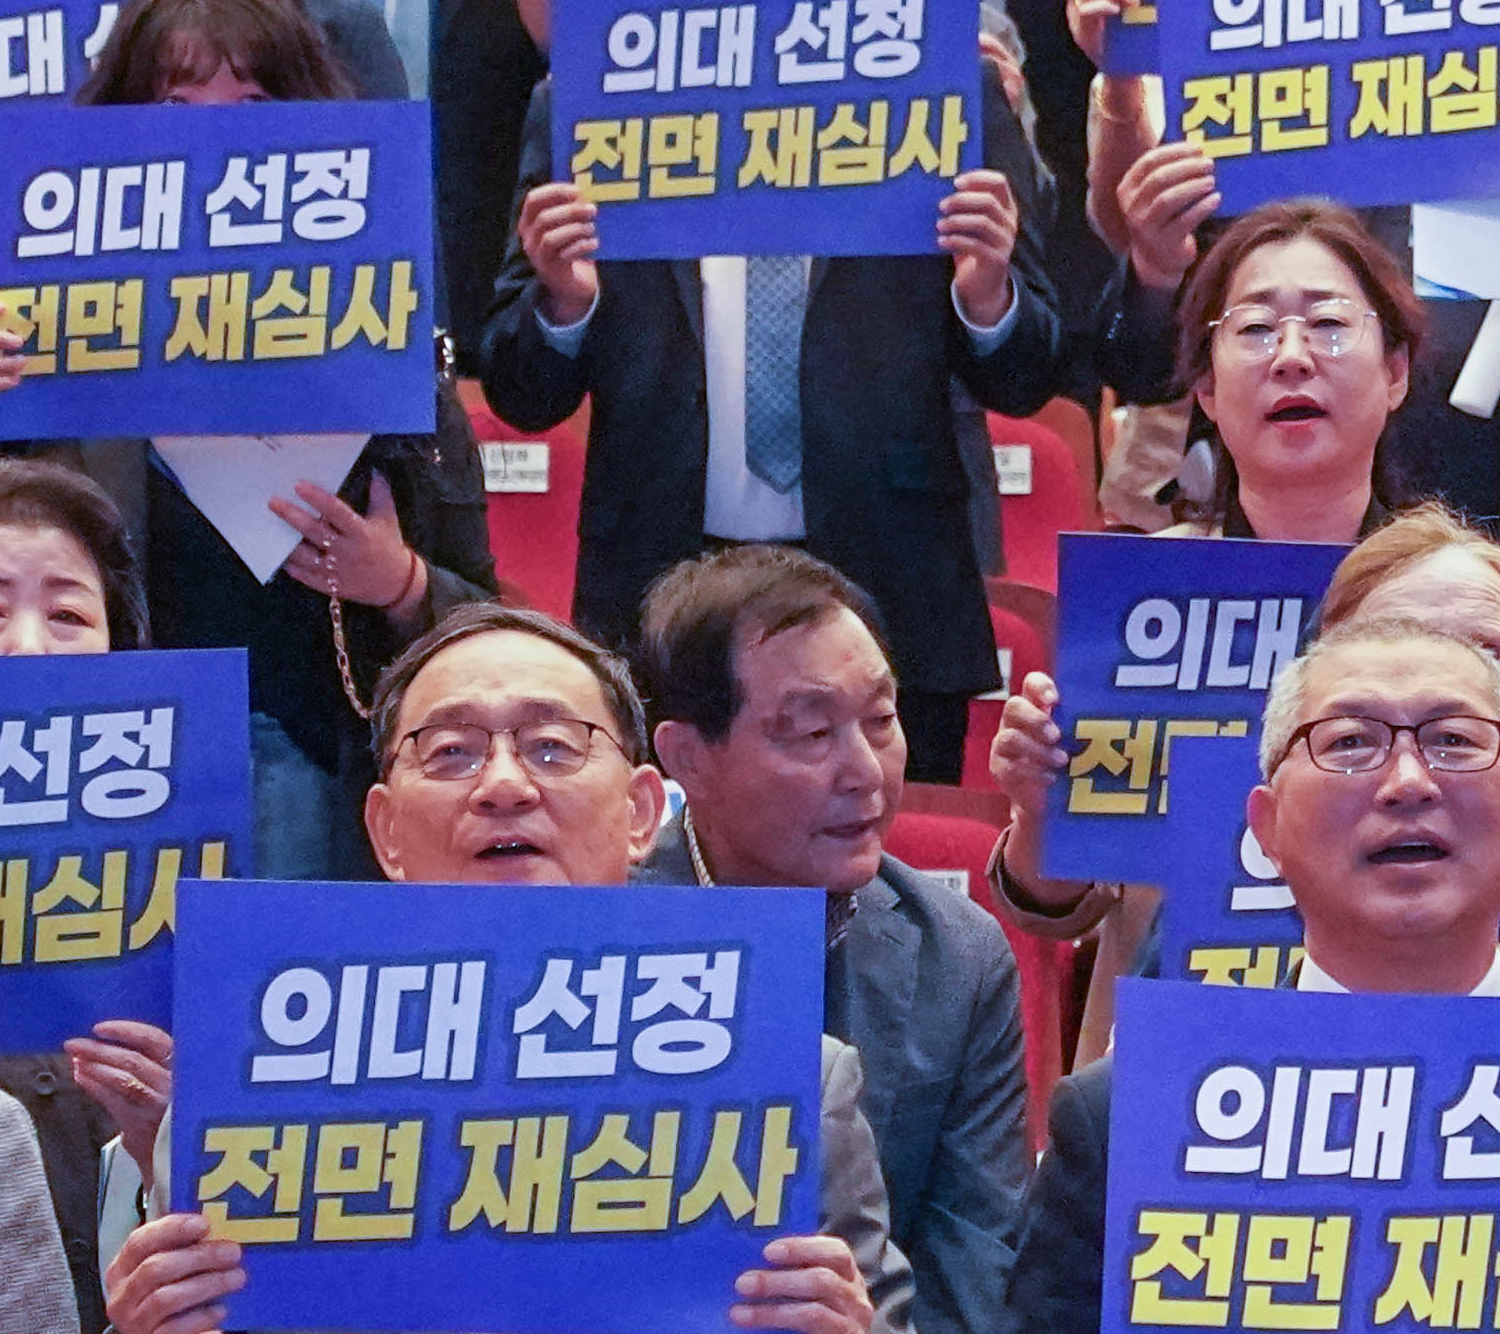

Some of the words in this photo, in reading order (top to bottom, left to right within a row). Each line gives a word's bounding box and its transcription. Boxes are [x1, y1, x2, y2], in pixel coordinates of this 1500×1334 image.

[604, 5, 756, 92] 의대
[564, 115, 716, 213] 전면
[740, 99, 964, 184] 재심사
[1184, 67, 1327, 169] 전면
[18, 161, 184, 257] 의대
[206, 149, 370, 246] 선정
[168, 263, 415, 359] 재심사
[251, 961, 486, 1084] 의대
[513, 951, 740, 1078] 선정
[202, 1123, 418, 1242] 전면
[452, 1109, 793, 1230] 재심사
[1185, 1067, 1415, 1179] 의대
[1133, 1213, 1349, 1328] 전면
